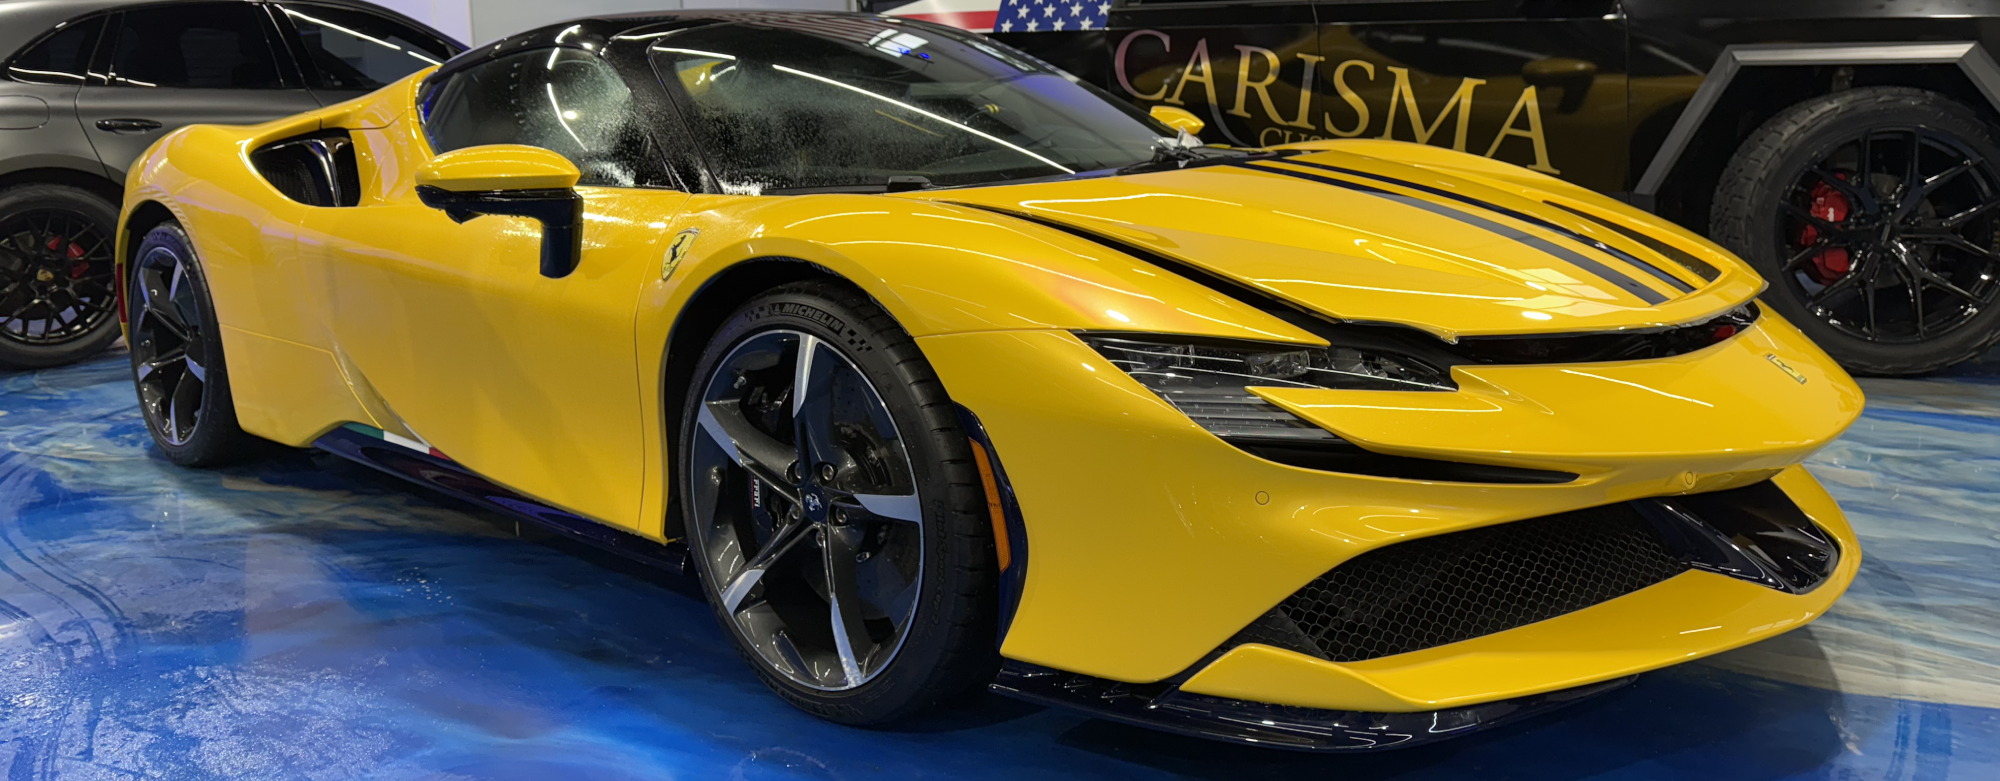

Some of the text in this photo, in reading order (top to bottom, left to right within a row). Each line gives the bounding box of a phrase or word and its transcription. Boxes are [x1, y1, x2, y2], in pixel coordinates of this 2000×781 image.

[1114, 29, 1560, 174] CARISMA
[781, 304, 844, 331] MICHELIN
[936, 539, 947, 583] Sport
[933, 586, 944, 611] Cup
